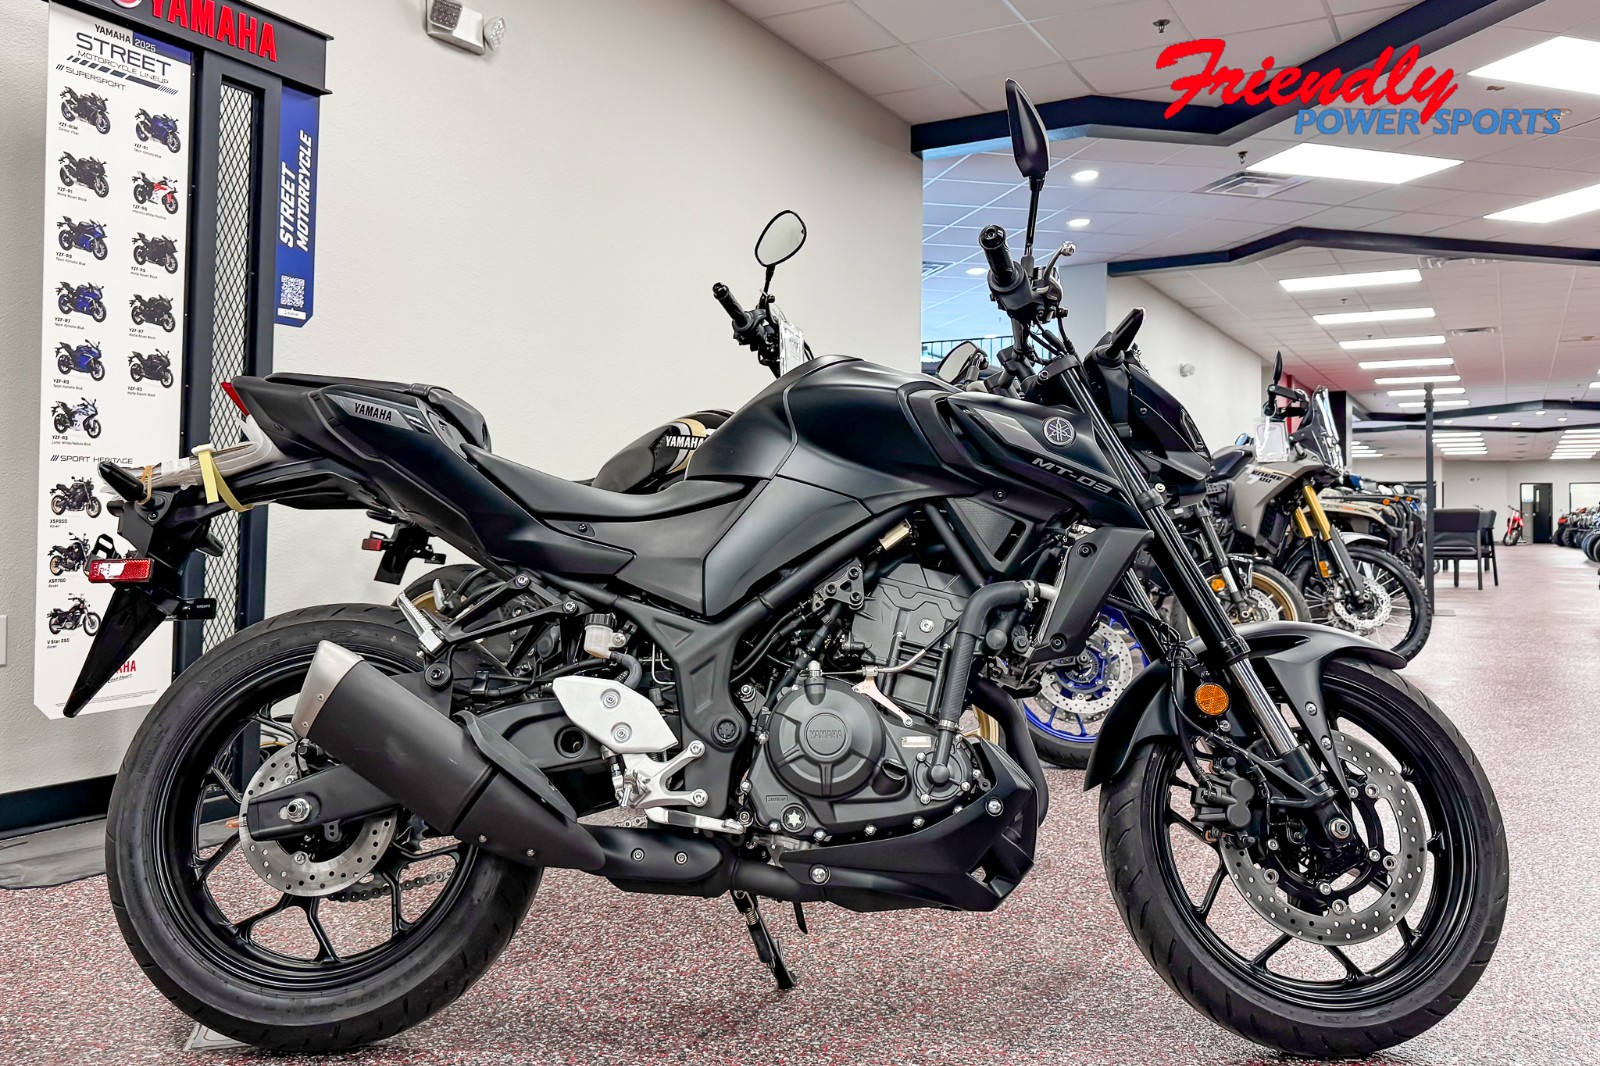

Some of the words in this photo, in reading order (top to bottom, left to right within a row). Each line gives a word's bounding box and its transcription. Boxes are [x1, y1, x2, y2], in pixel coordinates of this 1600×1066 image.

[94, 24, 131, 44] YAMAHA
[134, 38, 156, 53] 2025
[151, 0, 277, 62] YAMAHA
[76, 31, 172, 76] STREET
[77, 50, 137, 74] MOTORCYCLE
[139, 70, 169, 84] LINEUP
[65, 66, 126, 91] SUPERSPORT
[279, 161, 296, 248] STREET
[296, 129, 312, 252] MOTORCYCLE
[354, 402, 392, 422] YAMAHA
[666, 435, 704, 448] YAMAHA
[60, 454, 91, 463] SPORT
[93, 456, 133, 465] HERITAGE
[1031, 457, 1113, 494] MT-03
[809, 729, 843, 739] YAMAHA
